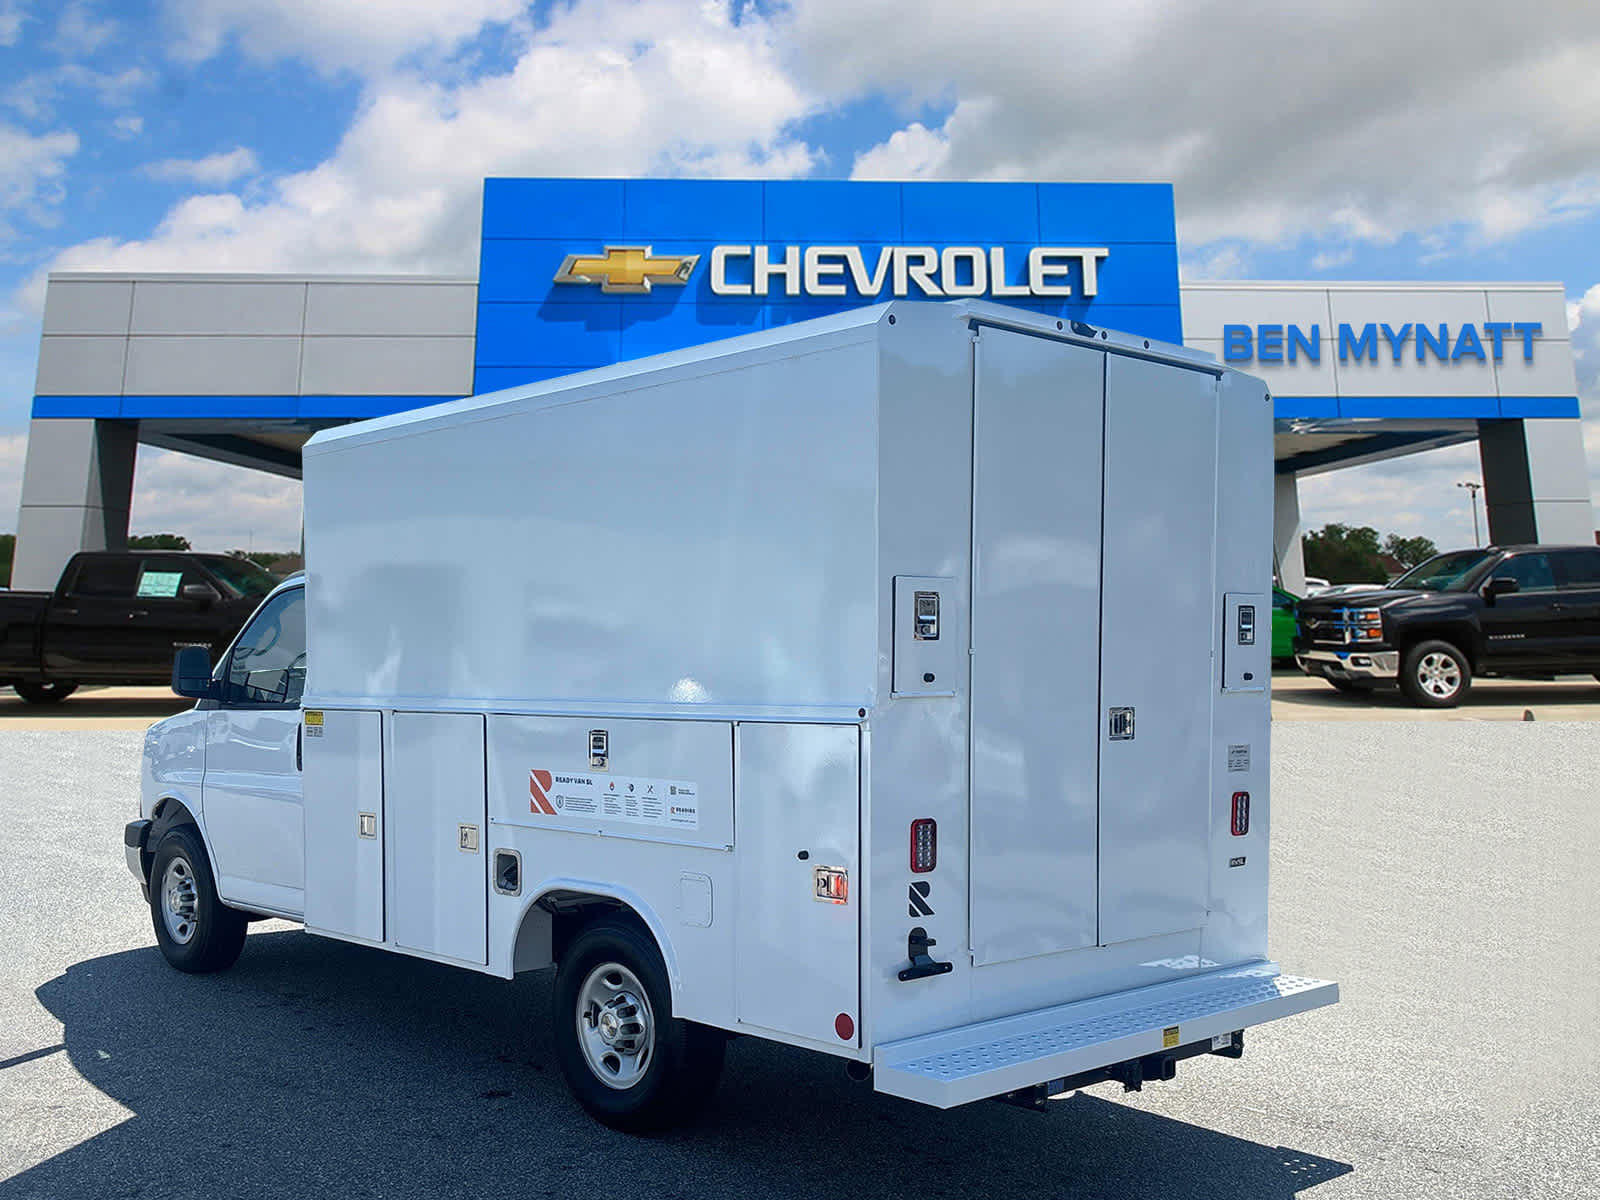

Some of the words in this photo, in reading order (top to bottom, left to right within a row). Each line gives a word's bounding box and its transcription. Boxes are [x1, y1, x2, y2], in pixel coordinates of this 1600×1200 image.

[711, 245, 1109, 296] CHEVROLET
[1223, 323, 1320, 361] BEN
[1338, 322, 1543, 361] MYNATT
[555, 776, 573, 784] READY
[573, 777, 586, 785] VAN
